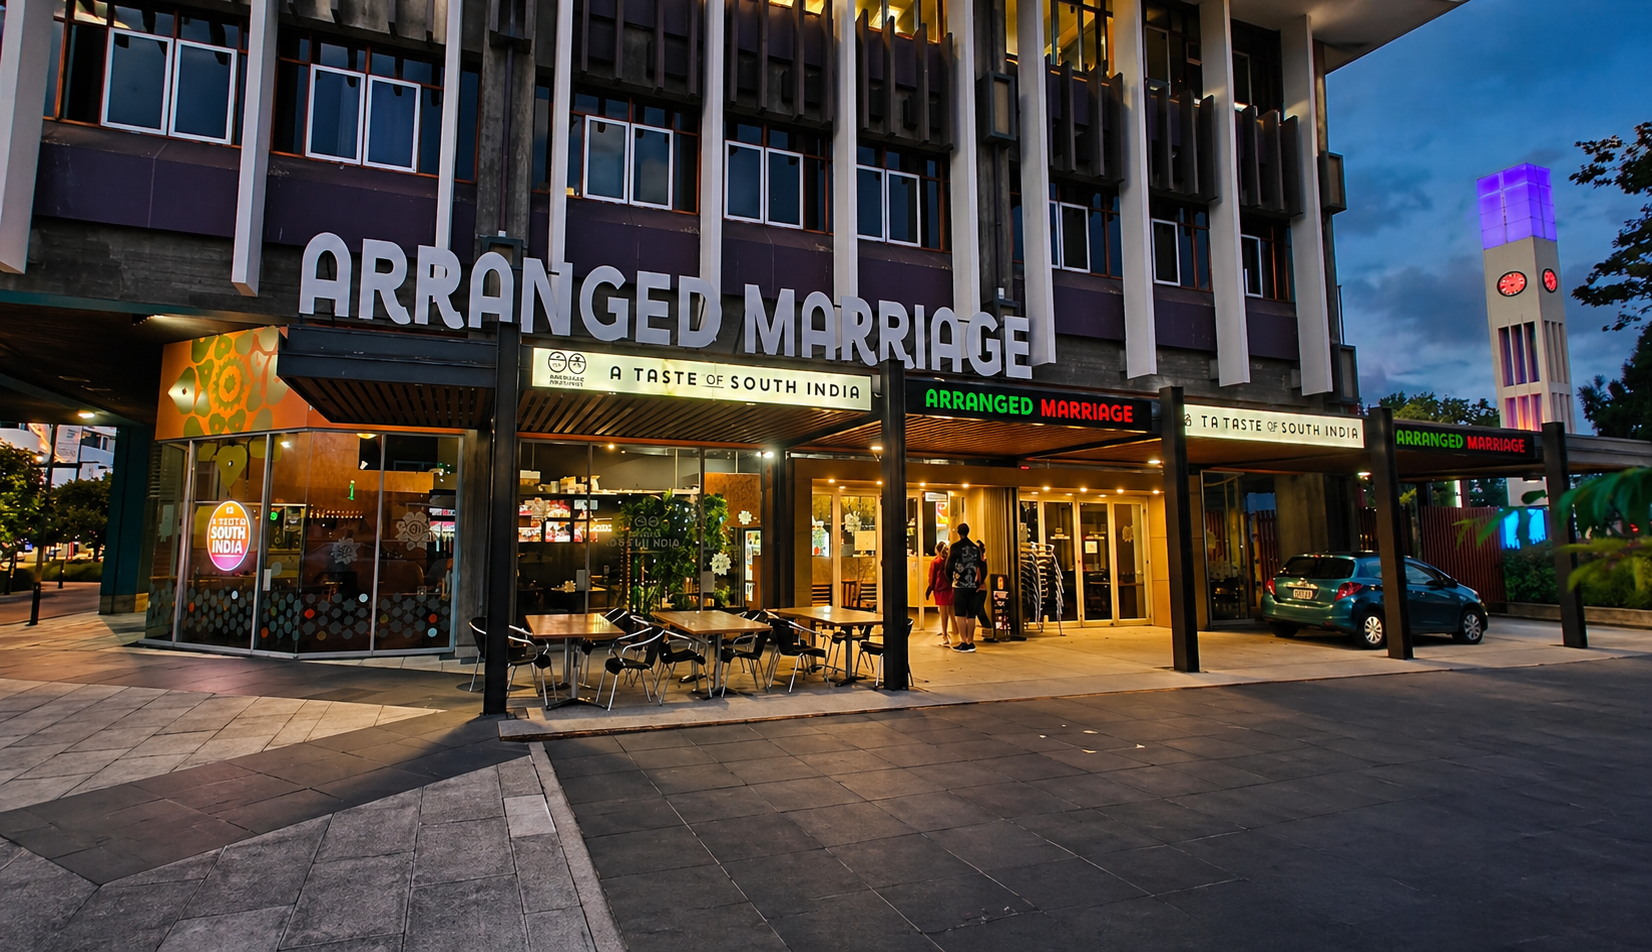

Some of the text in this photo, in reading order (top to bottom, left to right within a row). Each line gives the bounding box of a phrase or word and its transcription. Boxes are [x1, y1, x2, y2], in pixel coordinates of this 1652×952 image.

[299, 232, 1033, 380] ARRANGED MARRIAGE
[610, 366, 860, 399] A TASTE OF SOUTH INDIA
[925, 388, 1133, 423] ARRANGED MARRIAGE
[1223, 417, 1262, 431] TASTE
[1281, 422, 1320, 436] SOUTH
[1325, 425, 1359, 439] INDIA
[1396, 429, 1526, 453] ARRANGED MARRIAGE
[210, 526, 246, 540] SOUTH
[212, 540, 243, 554] INDIA
